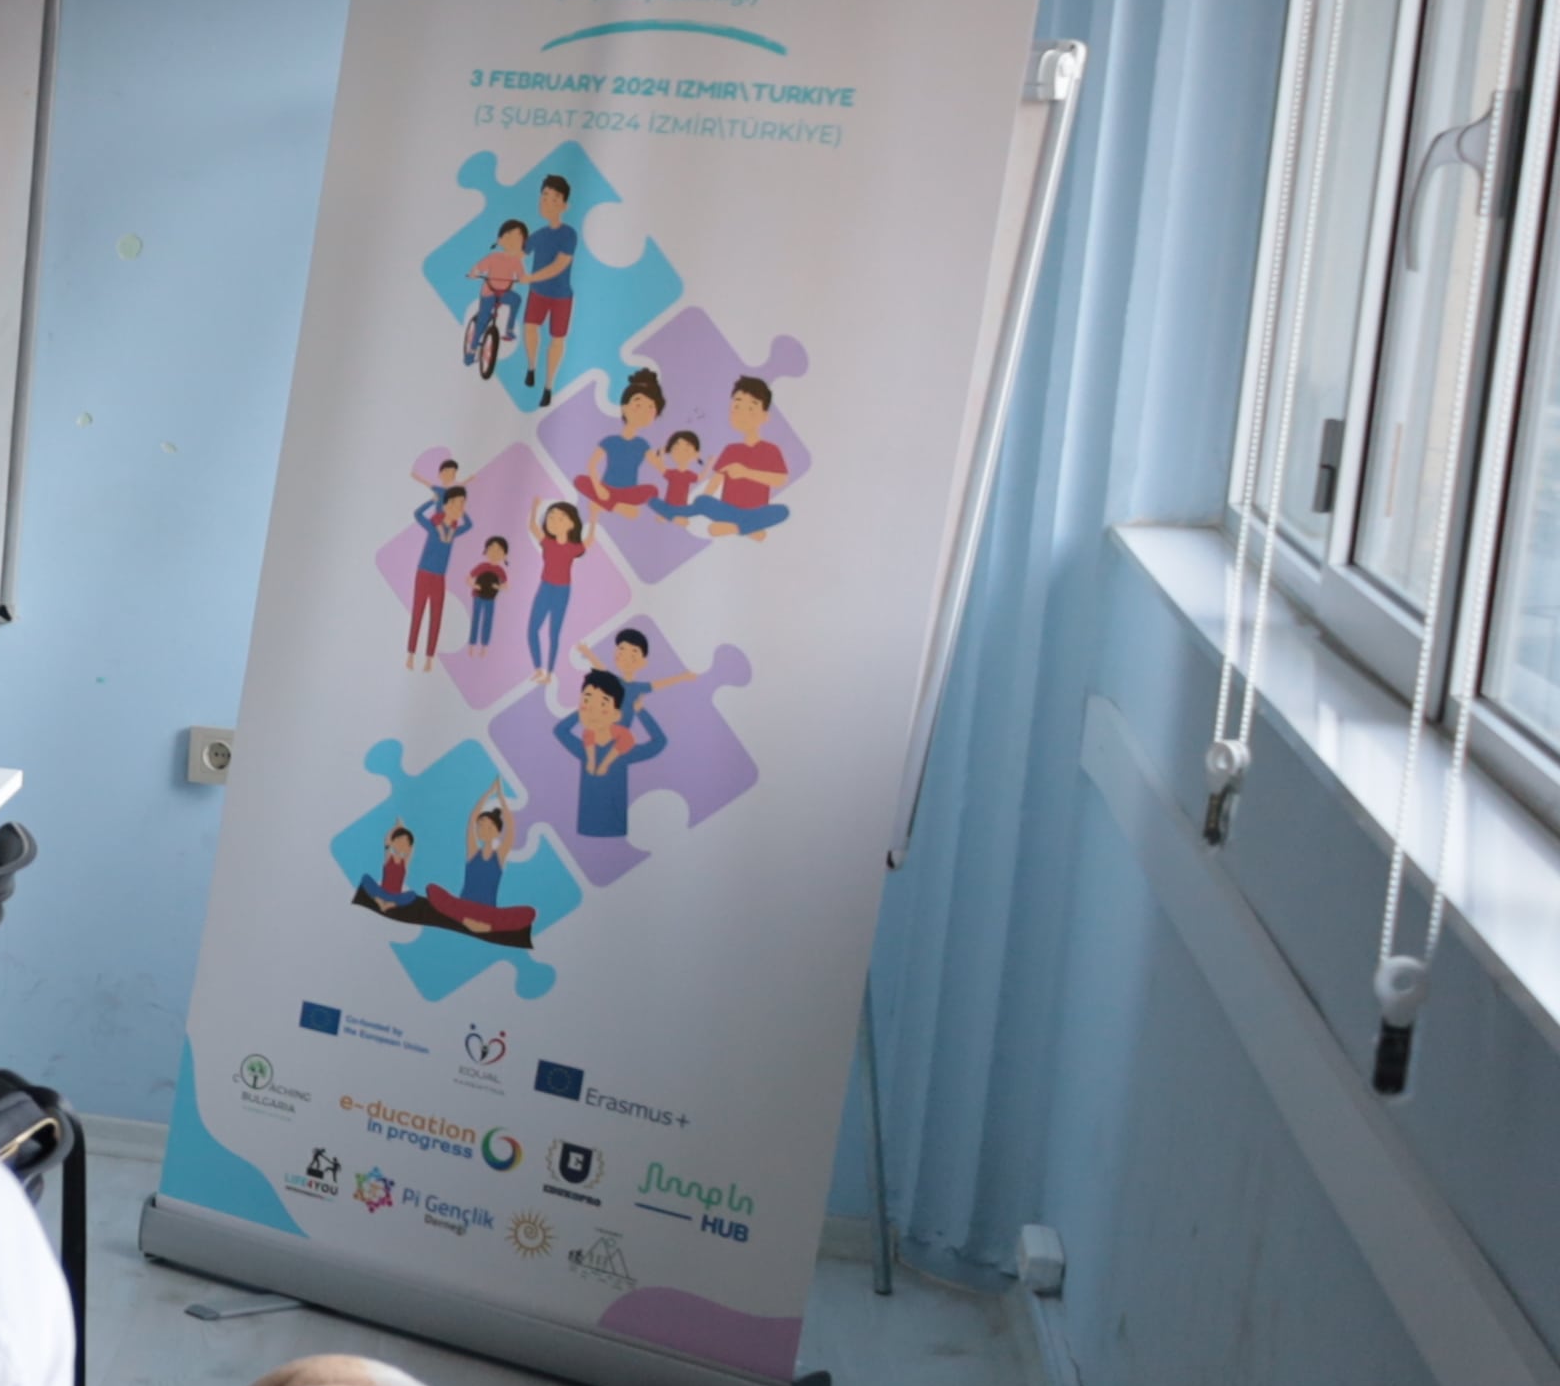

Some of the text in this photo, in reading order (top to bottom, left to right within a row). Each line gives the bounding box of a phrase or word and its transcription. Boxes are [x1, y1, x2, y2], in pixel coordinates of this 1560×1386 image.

[469, 69, 484, 88] 3
[489, 70, 607, 94] FEBRUARY
[612, 75, 670, 97] 2024
[581, 111, 641, 133] 2024
[339, 1094, 477, 1144] e-ducation
[366, 1117, 474, 1160] in progress
[400, 1187, 496, 1231] Pi Gençlik
[700, 1214, 750, 1244] HUB
